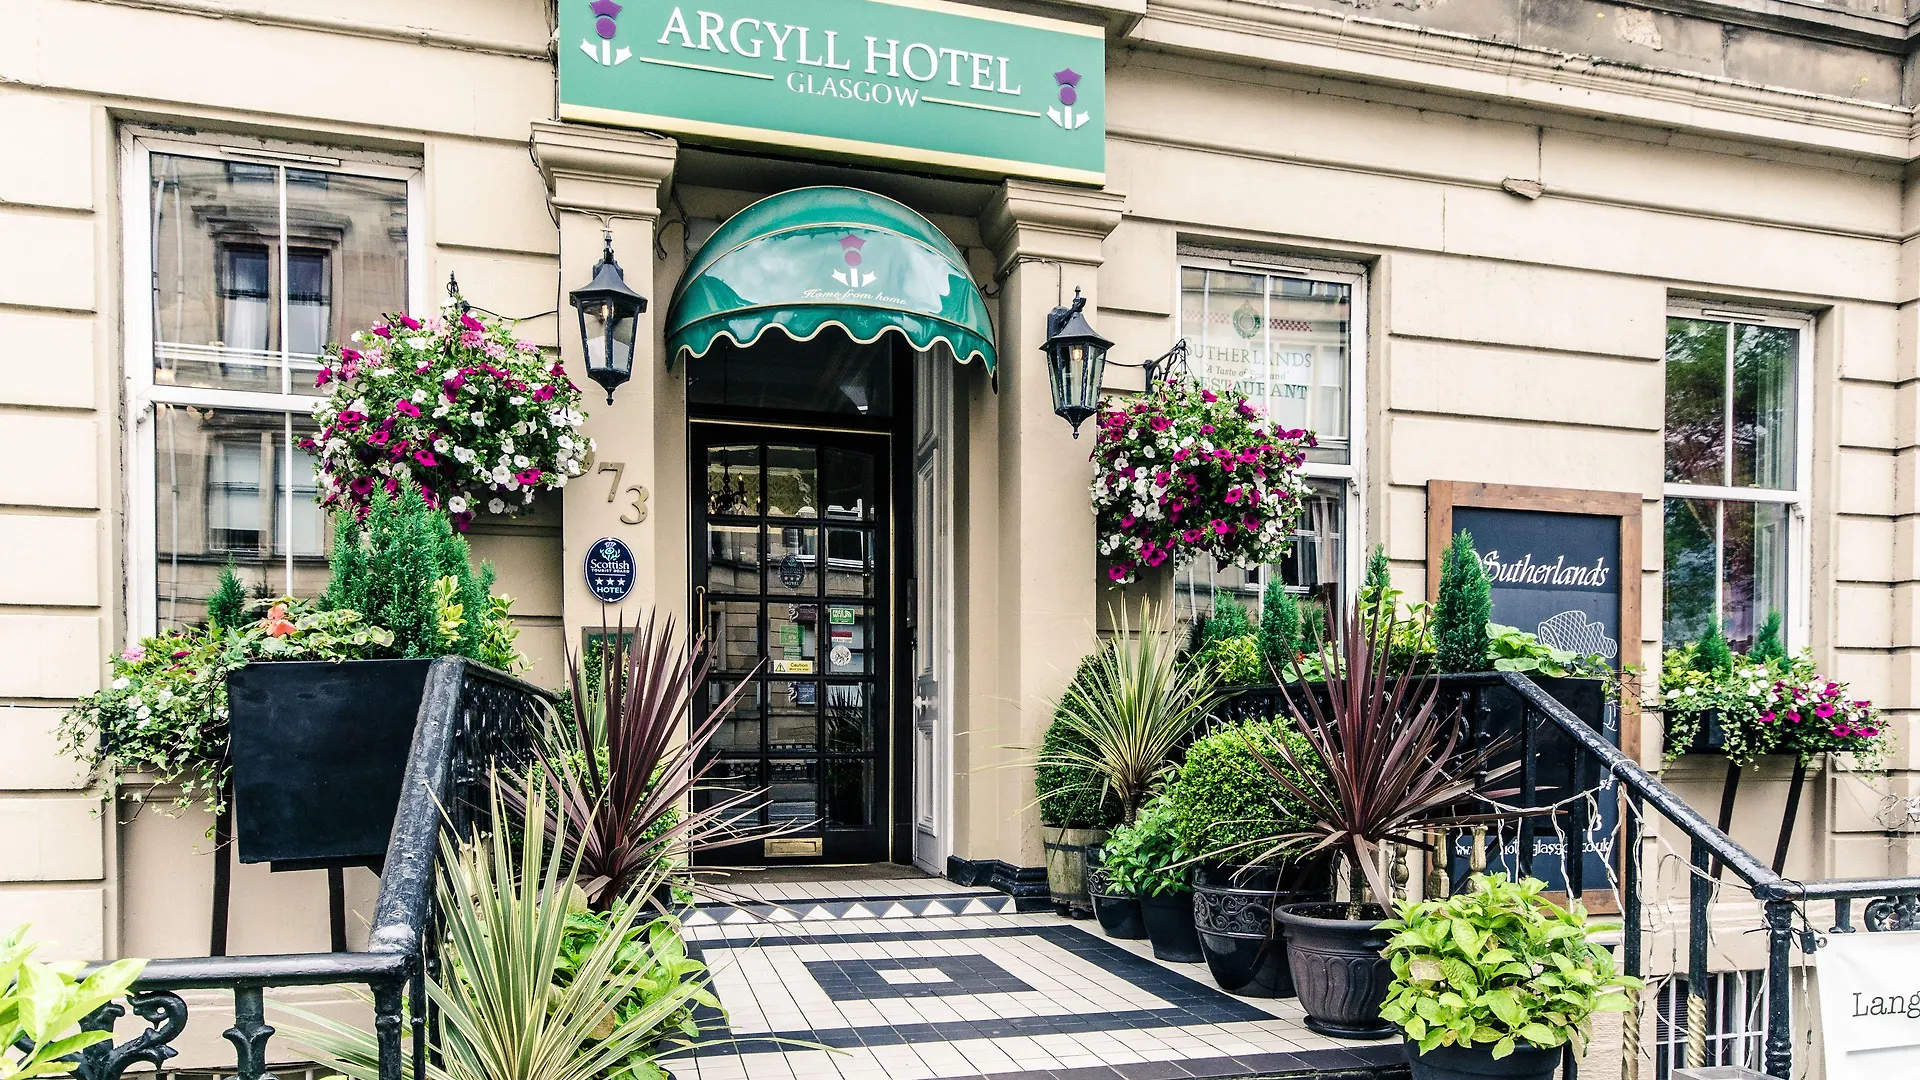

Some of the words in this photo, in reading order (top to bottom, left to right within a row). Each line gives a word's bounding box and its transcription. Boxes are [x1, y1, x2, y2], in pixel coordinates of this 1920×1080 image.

[657, 6, 851, 70] ARGYLL
[863, 35, 1022, 96] HOTEL
[786, 70, 921, 108] GLASGOW
[802, 288, 841, 300] Home
[838, 288, 873, 300] from
[875, 291, 908, 305] home
[1215, 365, 1237, 376] Taste
[590, 558, 630, 569] Scottish
[1473, 549, 1610, 588] Sutherlands
[596, 586, 625, 594] HOTEL
